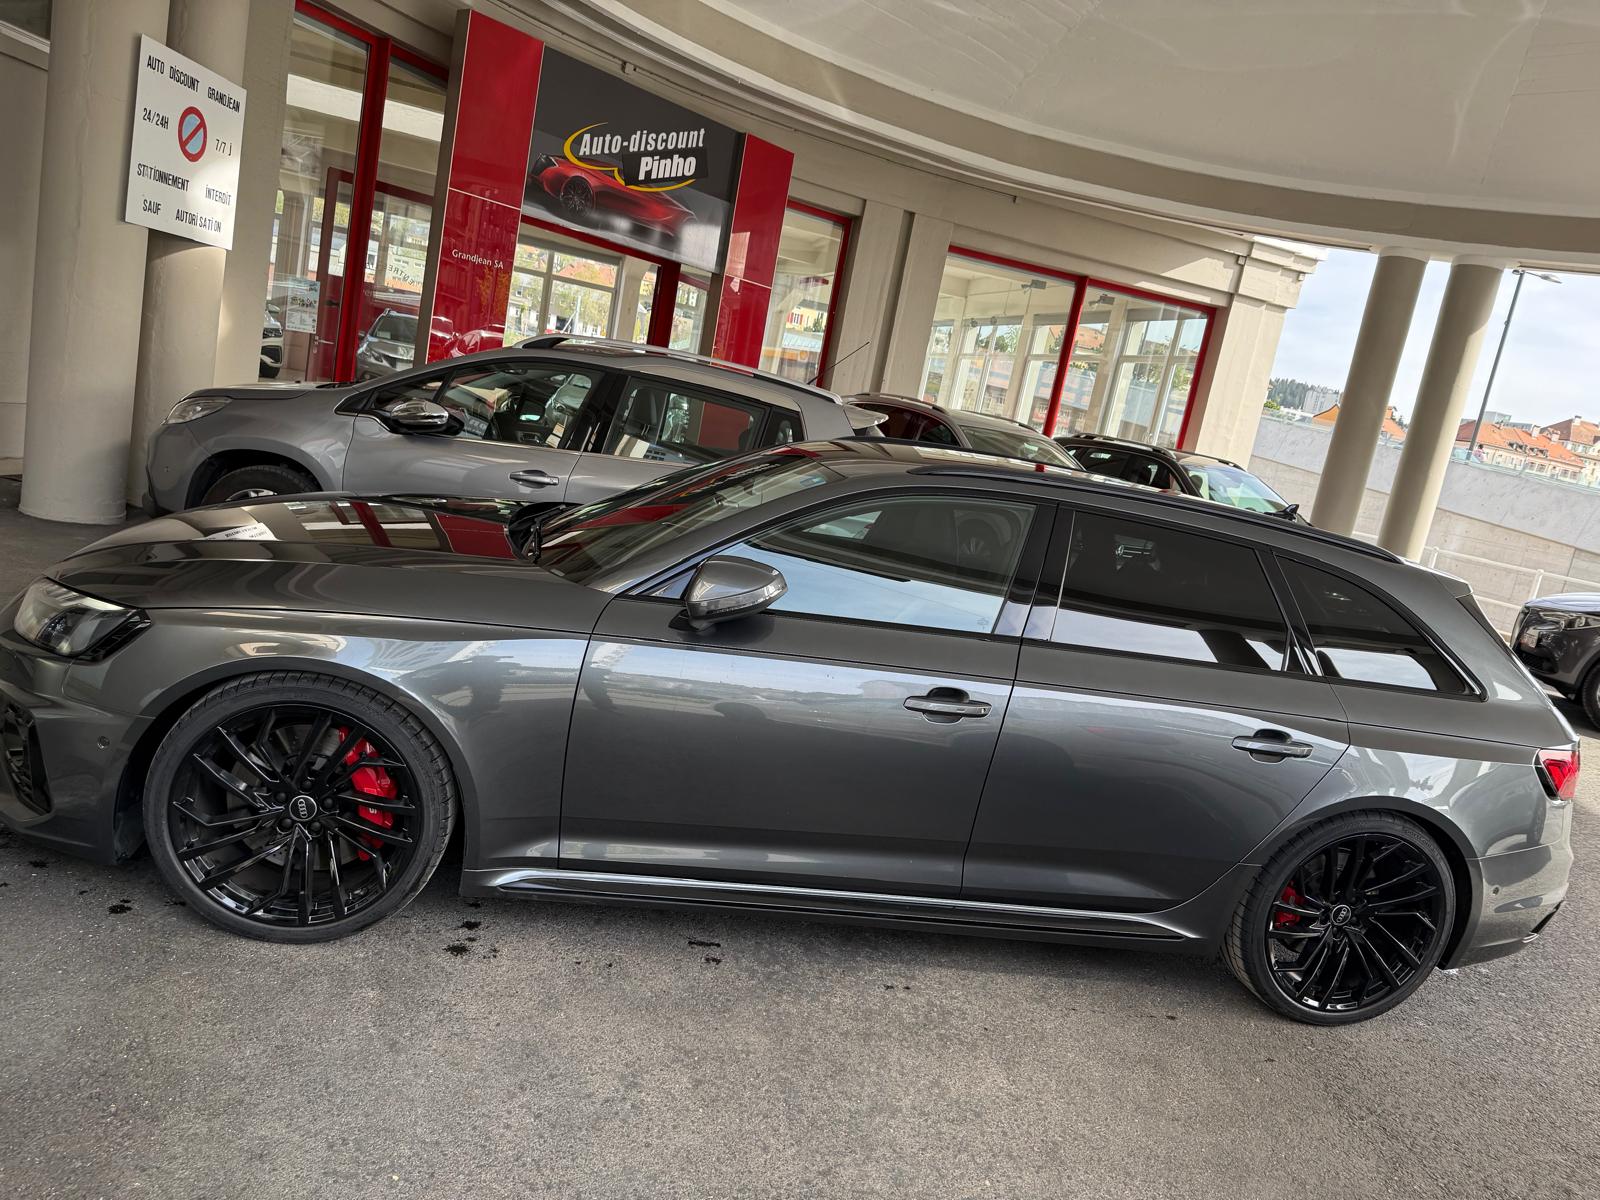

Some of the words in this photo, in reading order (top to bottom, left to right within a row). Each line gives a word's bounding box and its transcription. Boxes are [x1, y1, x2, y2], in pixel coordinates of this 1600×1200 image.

[147, 55, 165, 74] AUTO
[169, 65, 200, 92] DISCOUNT
[207, 86, 240, 113] GRANDJEAN
[142, 107, 169, 130] 24/24H
[579, 128, 706, 156] Auto-discount
[137, 163, 190, 192] STATIONNEMENT
[638, 154, 697, 181] Pinho
[142, 199, 161, 215] SAUF
[452, 249, 492, 265] Grandjean
[494, 259, 504, 270] SA
